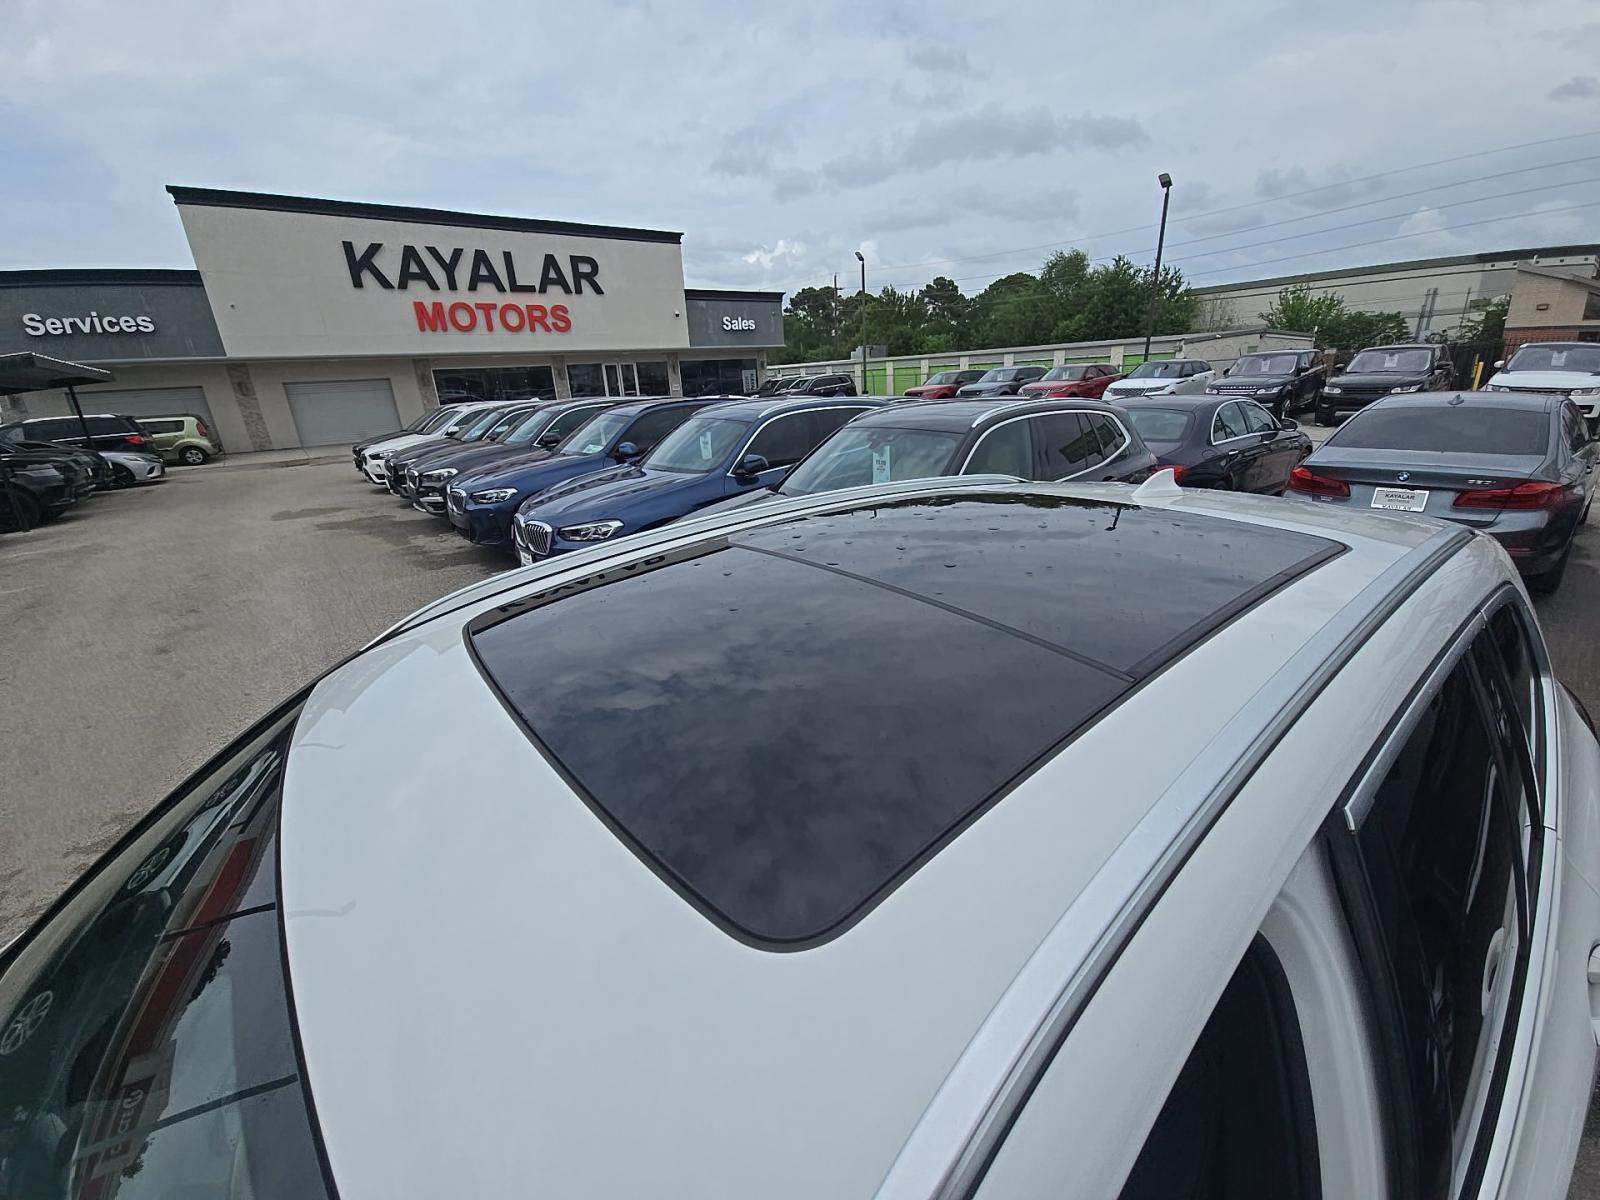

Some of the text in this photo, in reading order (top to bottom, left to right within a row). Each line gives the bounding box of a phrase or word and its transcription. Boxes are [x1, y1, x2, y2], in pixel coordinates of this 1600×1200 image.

[341, 240, 604, 295] KAYALAR
[22, 311, 156, 336] Services
[413, 301, 572, 333] MOTORS
[722, 316, 756, 331] Sales
[1384, 493, 1416, 501] KAYALAR
